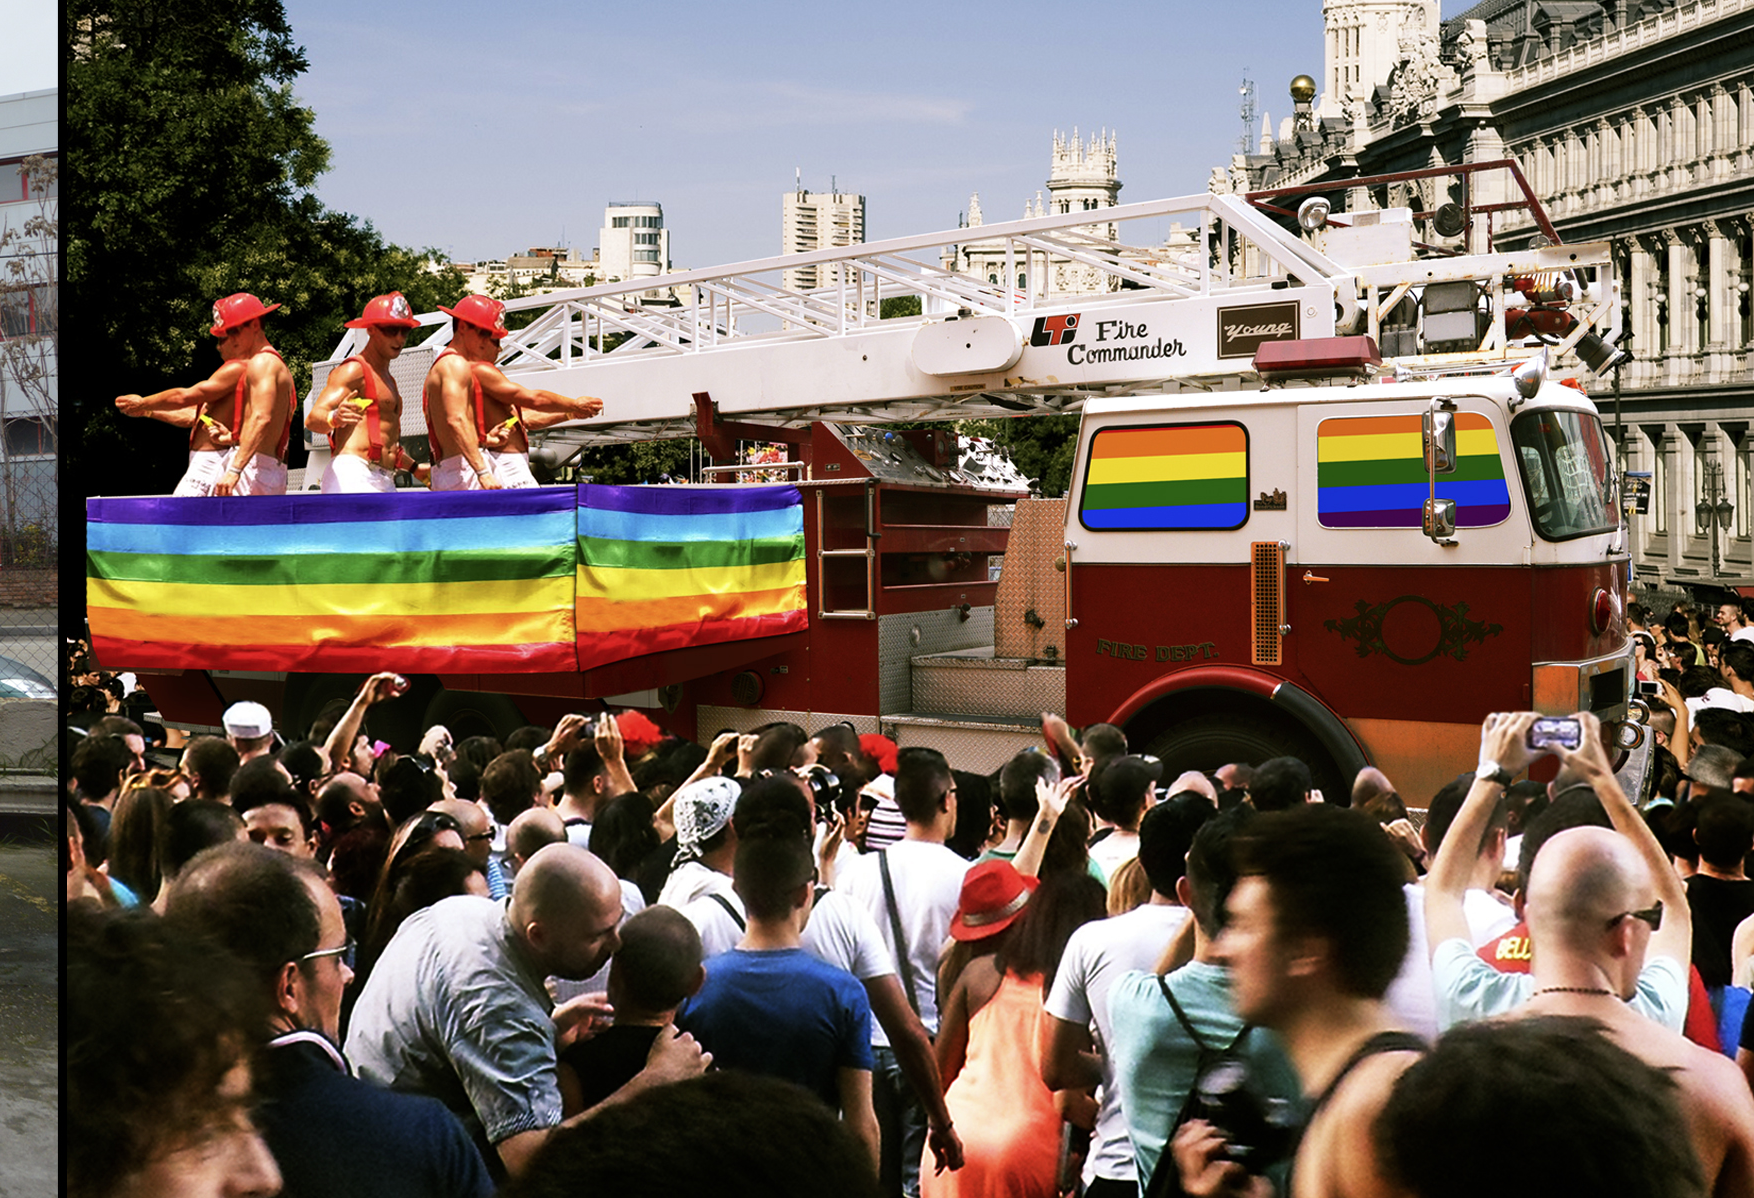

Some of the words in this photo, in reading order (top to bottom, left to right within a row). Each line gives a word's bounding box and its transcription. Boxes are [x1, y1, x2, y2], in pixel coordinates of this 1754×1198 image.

[1096, 320, 1148, 341] Fire
[1224, 322, 1293, 342] Young
[1067, 337, 1187, 365] Commander
[1096, 638, 1147, 661] FIRE
[1155, 641, 1219, 662] DEPT.
